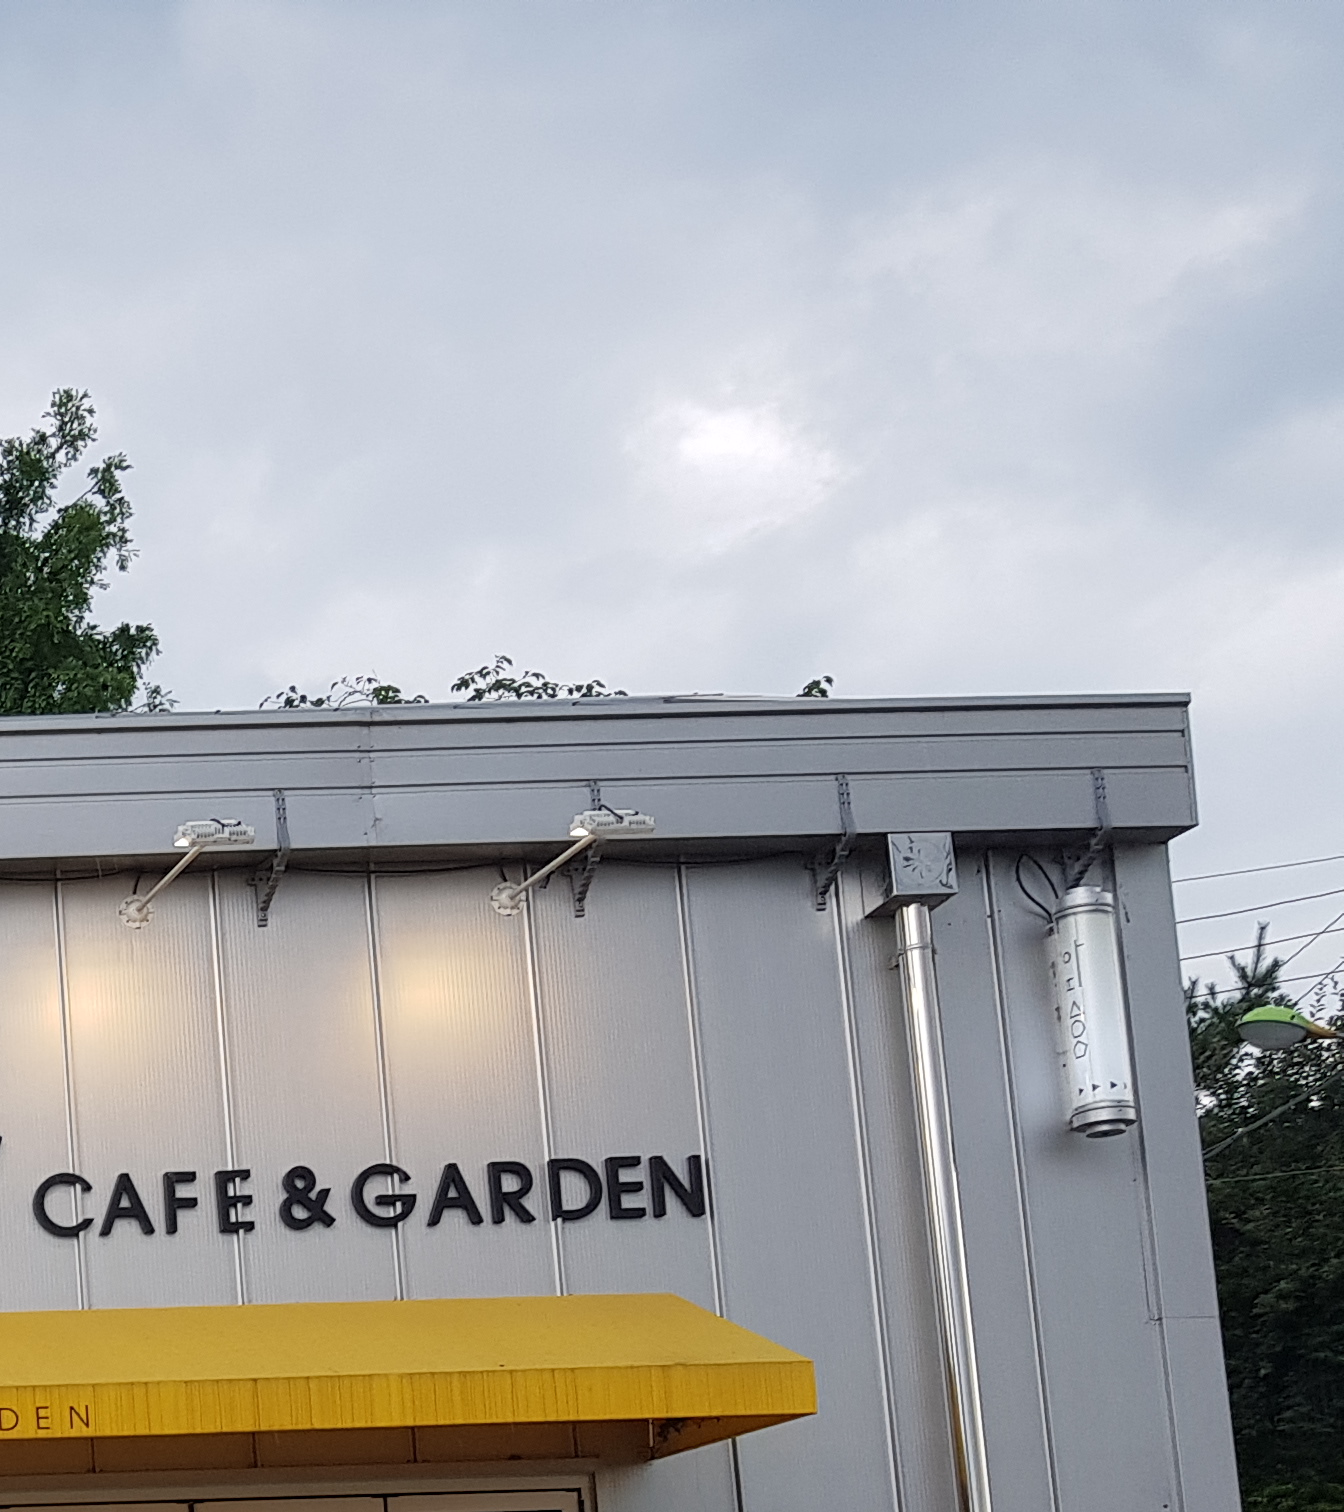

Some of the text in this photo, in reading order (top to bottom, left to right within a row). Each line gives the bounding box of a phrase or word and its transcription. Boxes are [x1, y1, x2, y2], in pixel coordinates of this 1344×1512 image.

[31, 1168, 257, 1242] CAFE
[279, 1165, 337, 1232] &
[350, 1153, 708, 1237] GARDEN
